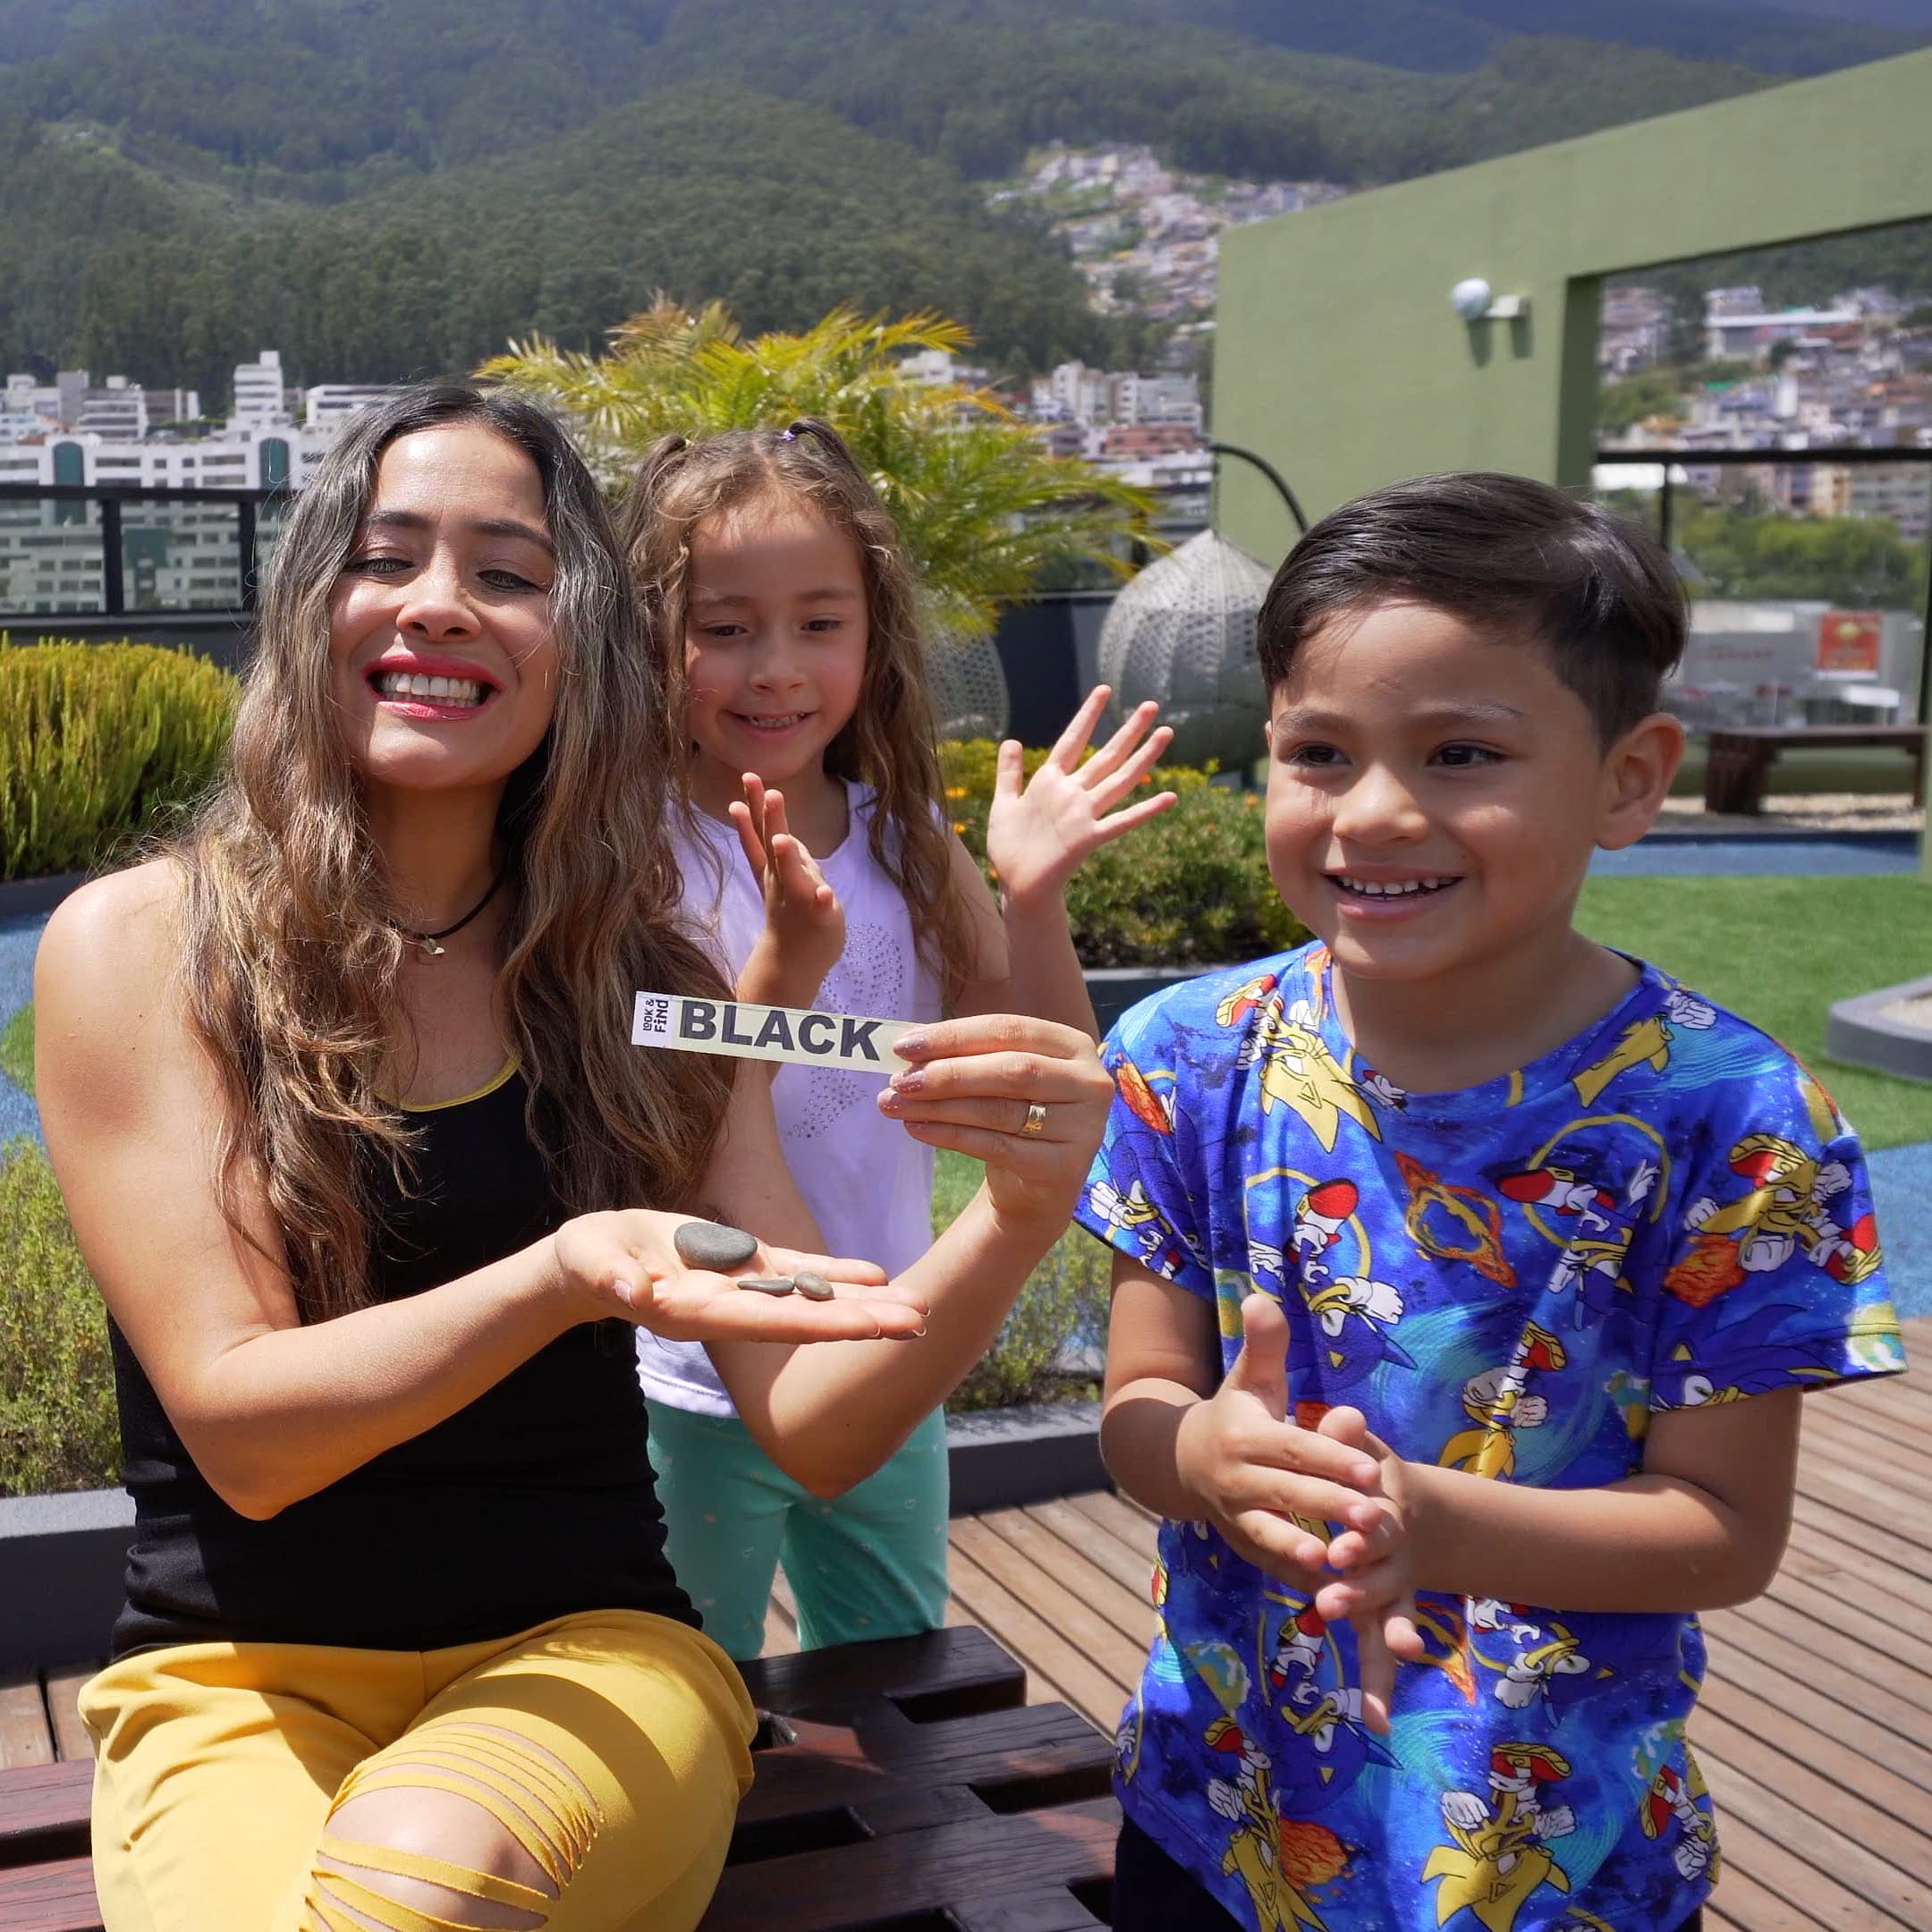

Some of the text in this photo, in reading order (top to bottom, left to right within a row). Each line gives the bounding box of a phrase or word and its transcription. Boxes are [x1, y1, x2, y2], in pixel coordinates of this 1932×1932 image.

[643, 998, 654, 1031] LOOK &
[679, 1000, 883, 1061] BLACK
